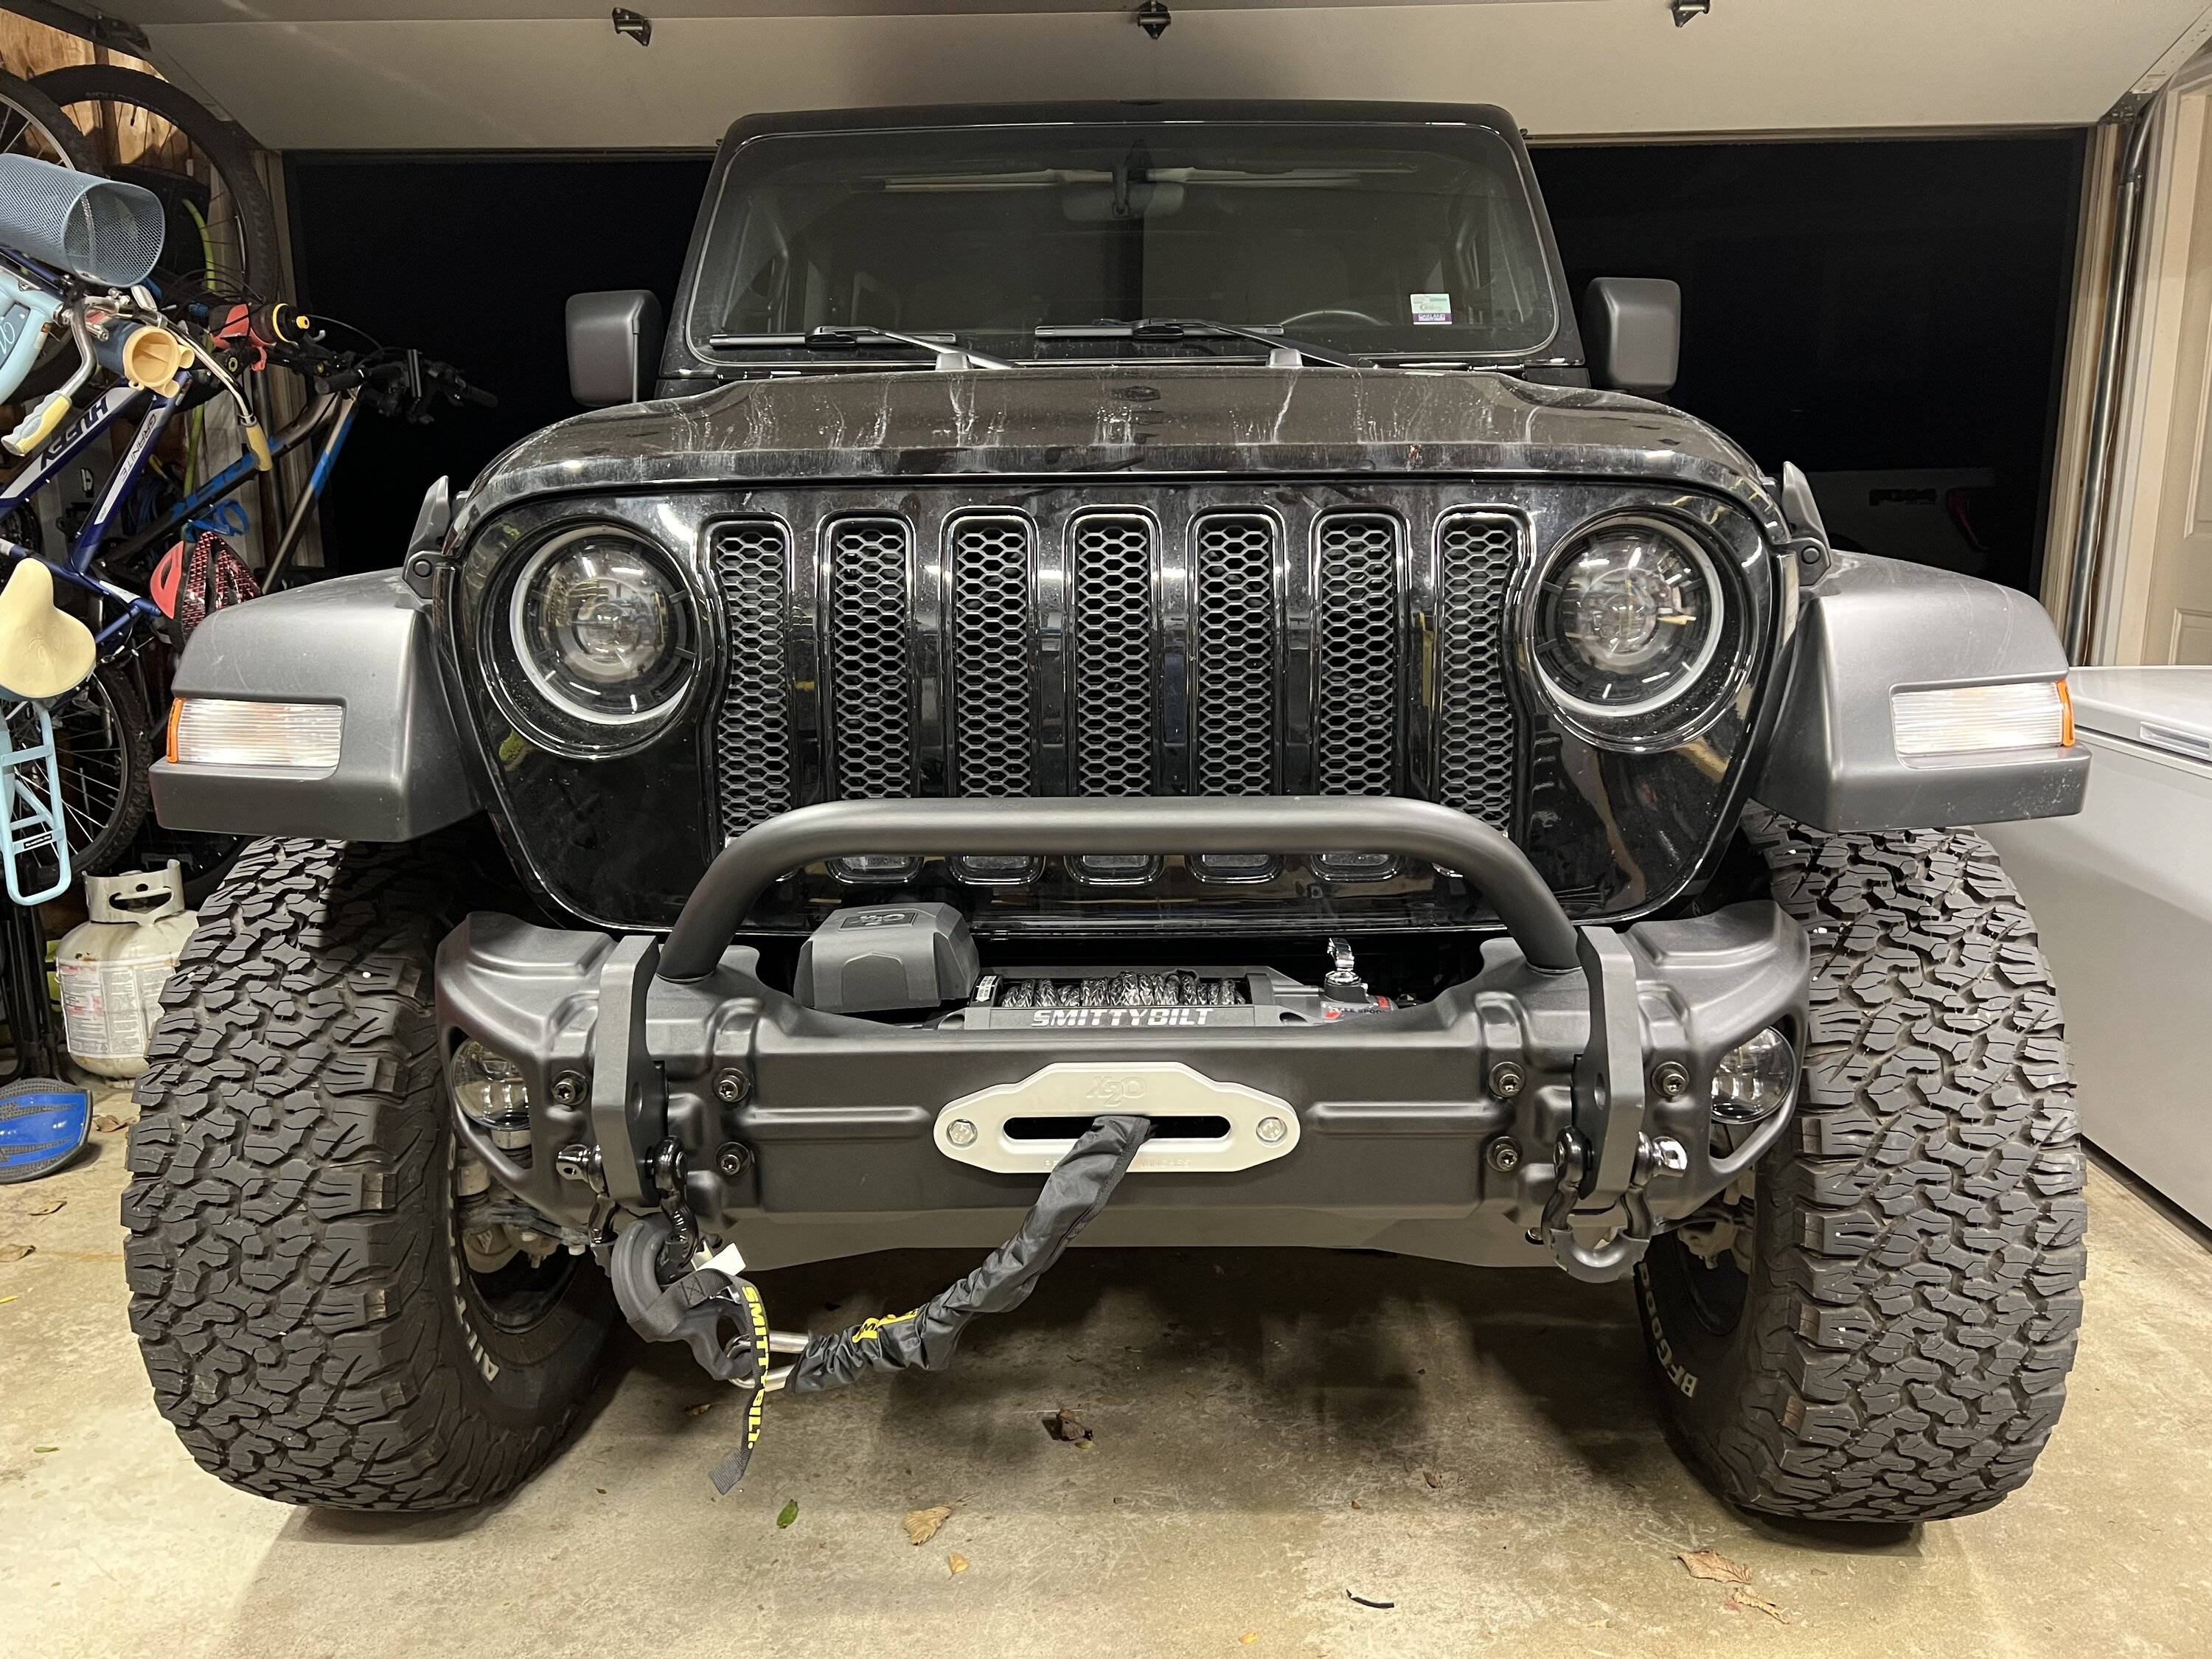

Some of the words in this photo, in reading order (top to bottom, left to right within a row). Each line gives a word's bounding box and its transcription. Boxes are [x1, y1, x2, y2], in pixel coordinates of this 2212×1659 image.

[40, 395, 108, 470] HUFFY
[119, 414, 156, 481] GRANITE
[1031, 1007, 1214, 1027] SMITTYBILT
[1638, 1262, 1699, 1398] BFGOOD
